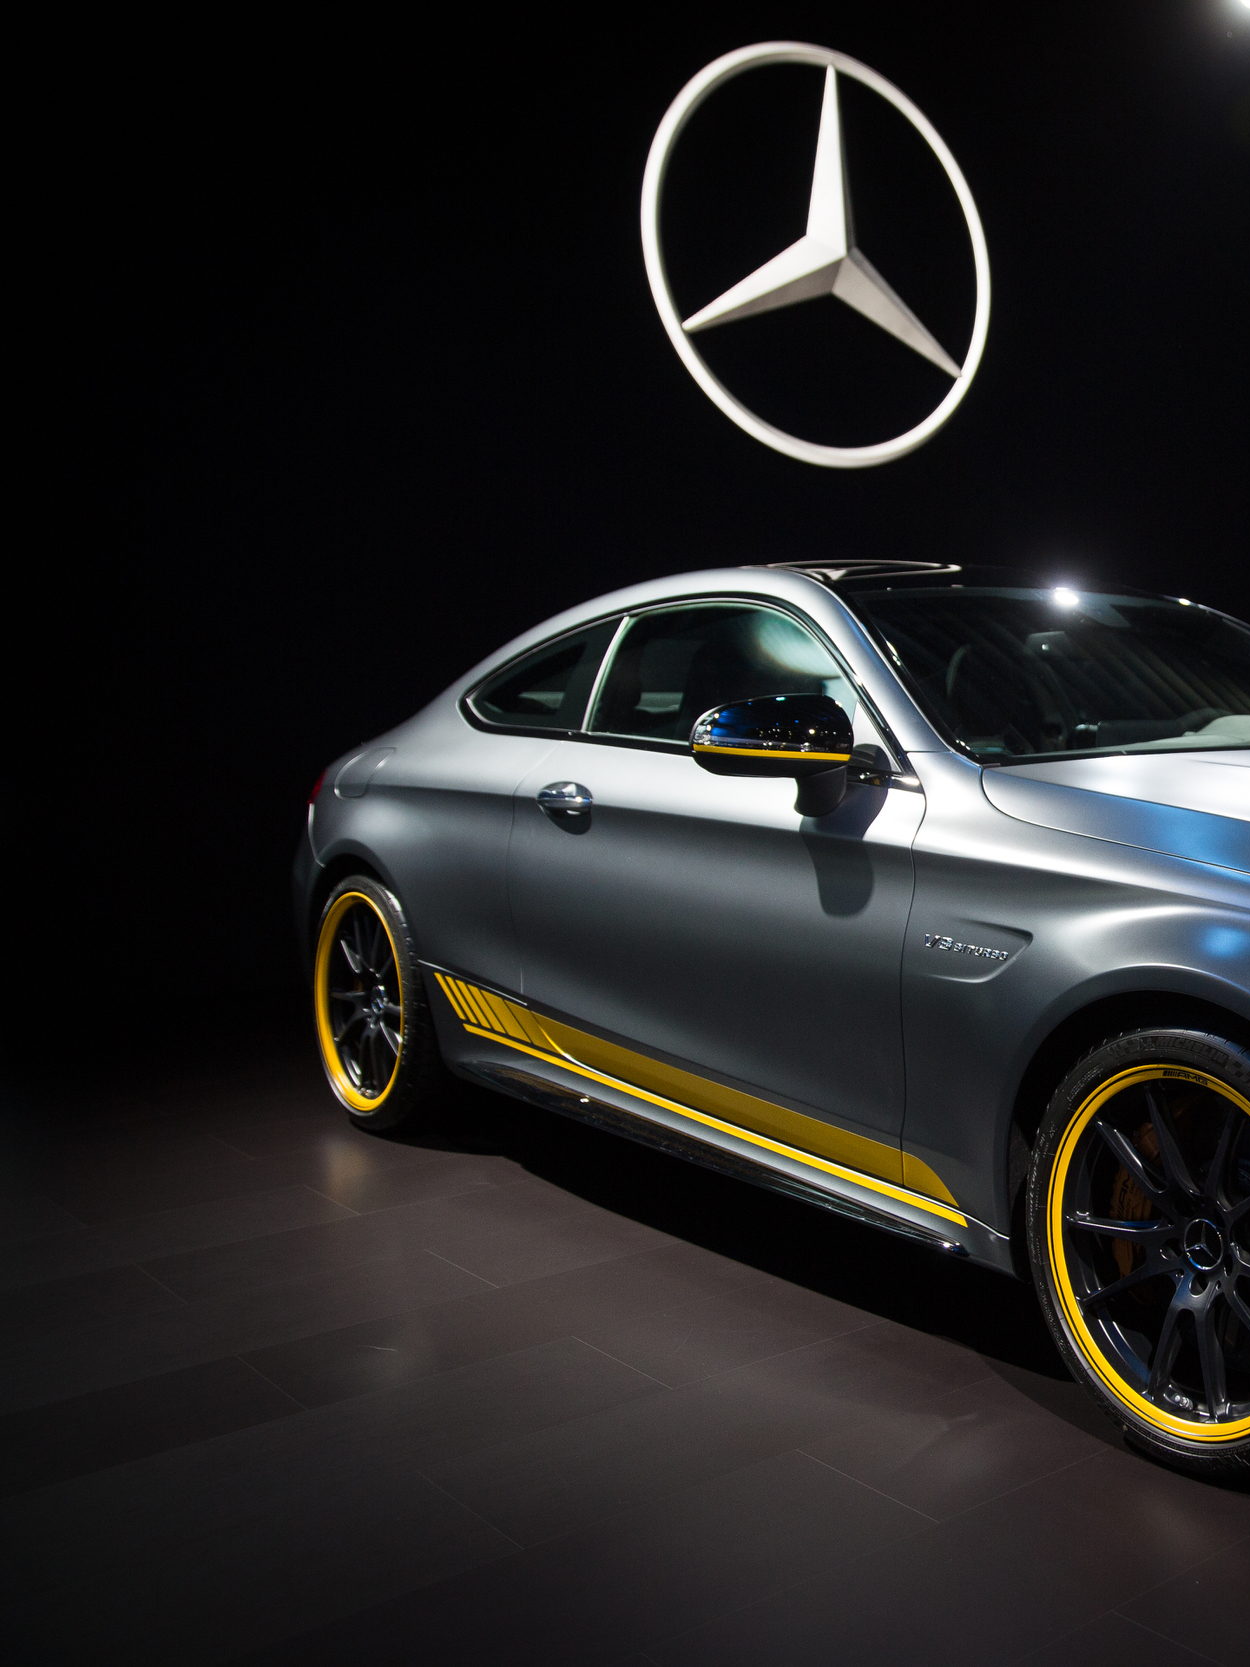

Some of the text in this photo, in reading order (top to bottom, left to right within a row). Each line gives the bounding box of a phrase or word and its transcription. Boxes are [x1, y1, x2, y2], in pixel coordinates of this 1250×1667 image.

[925, 933, 1009, 961] V8 BITURBO
[1155, 1035, 1230, 1068] MICHELIN
[1175, 1070, 1209, 1087] AMG
